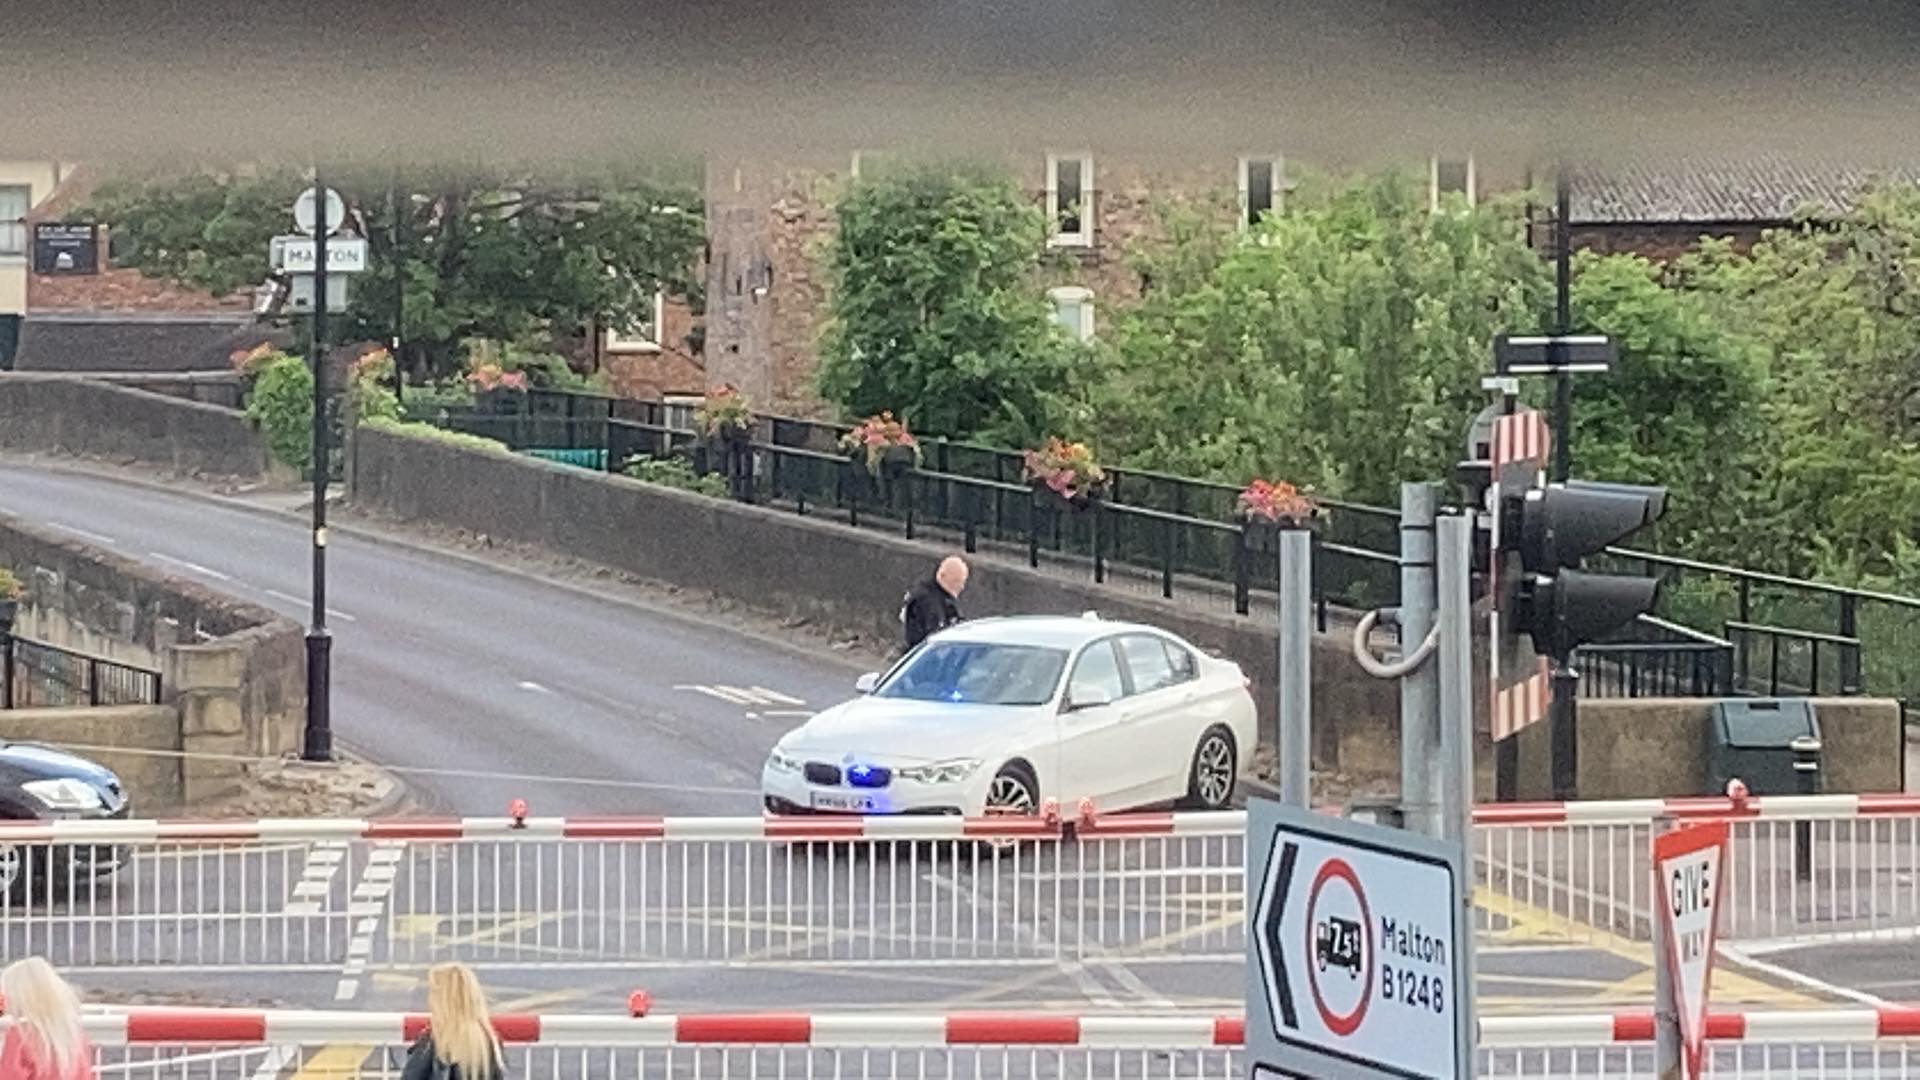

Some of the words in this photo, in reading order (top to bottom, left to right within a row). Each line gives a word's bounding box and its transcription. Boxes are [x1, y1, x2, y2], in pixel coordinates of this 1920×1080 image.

[288, 249, 359, 262] MATON
[1671, 860, 1709, 917] GIVE
[1380, 915, 1446, 966] Malton
[1381, 963, 1445, 1014] B1248
